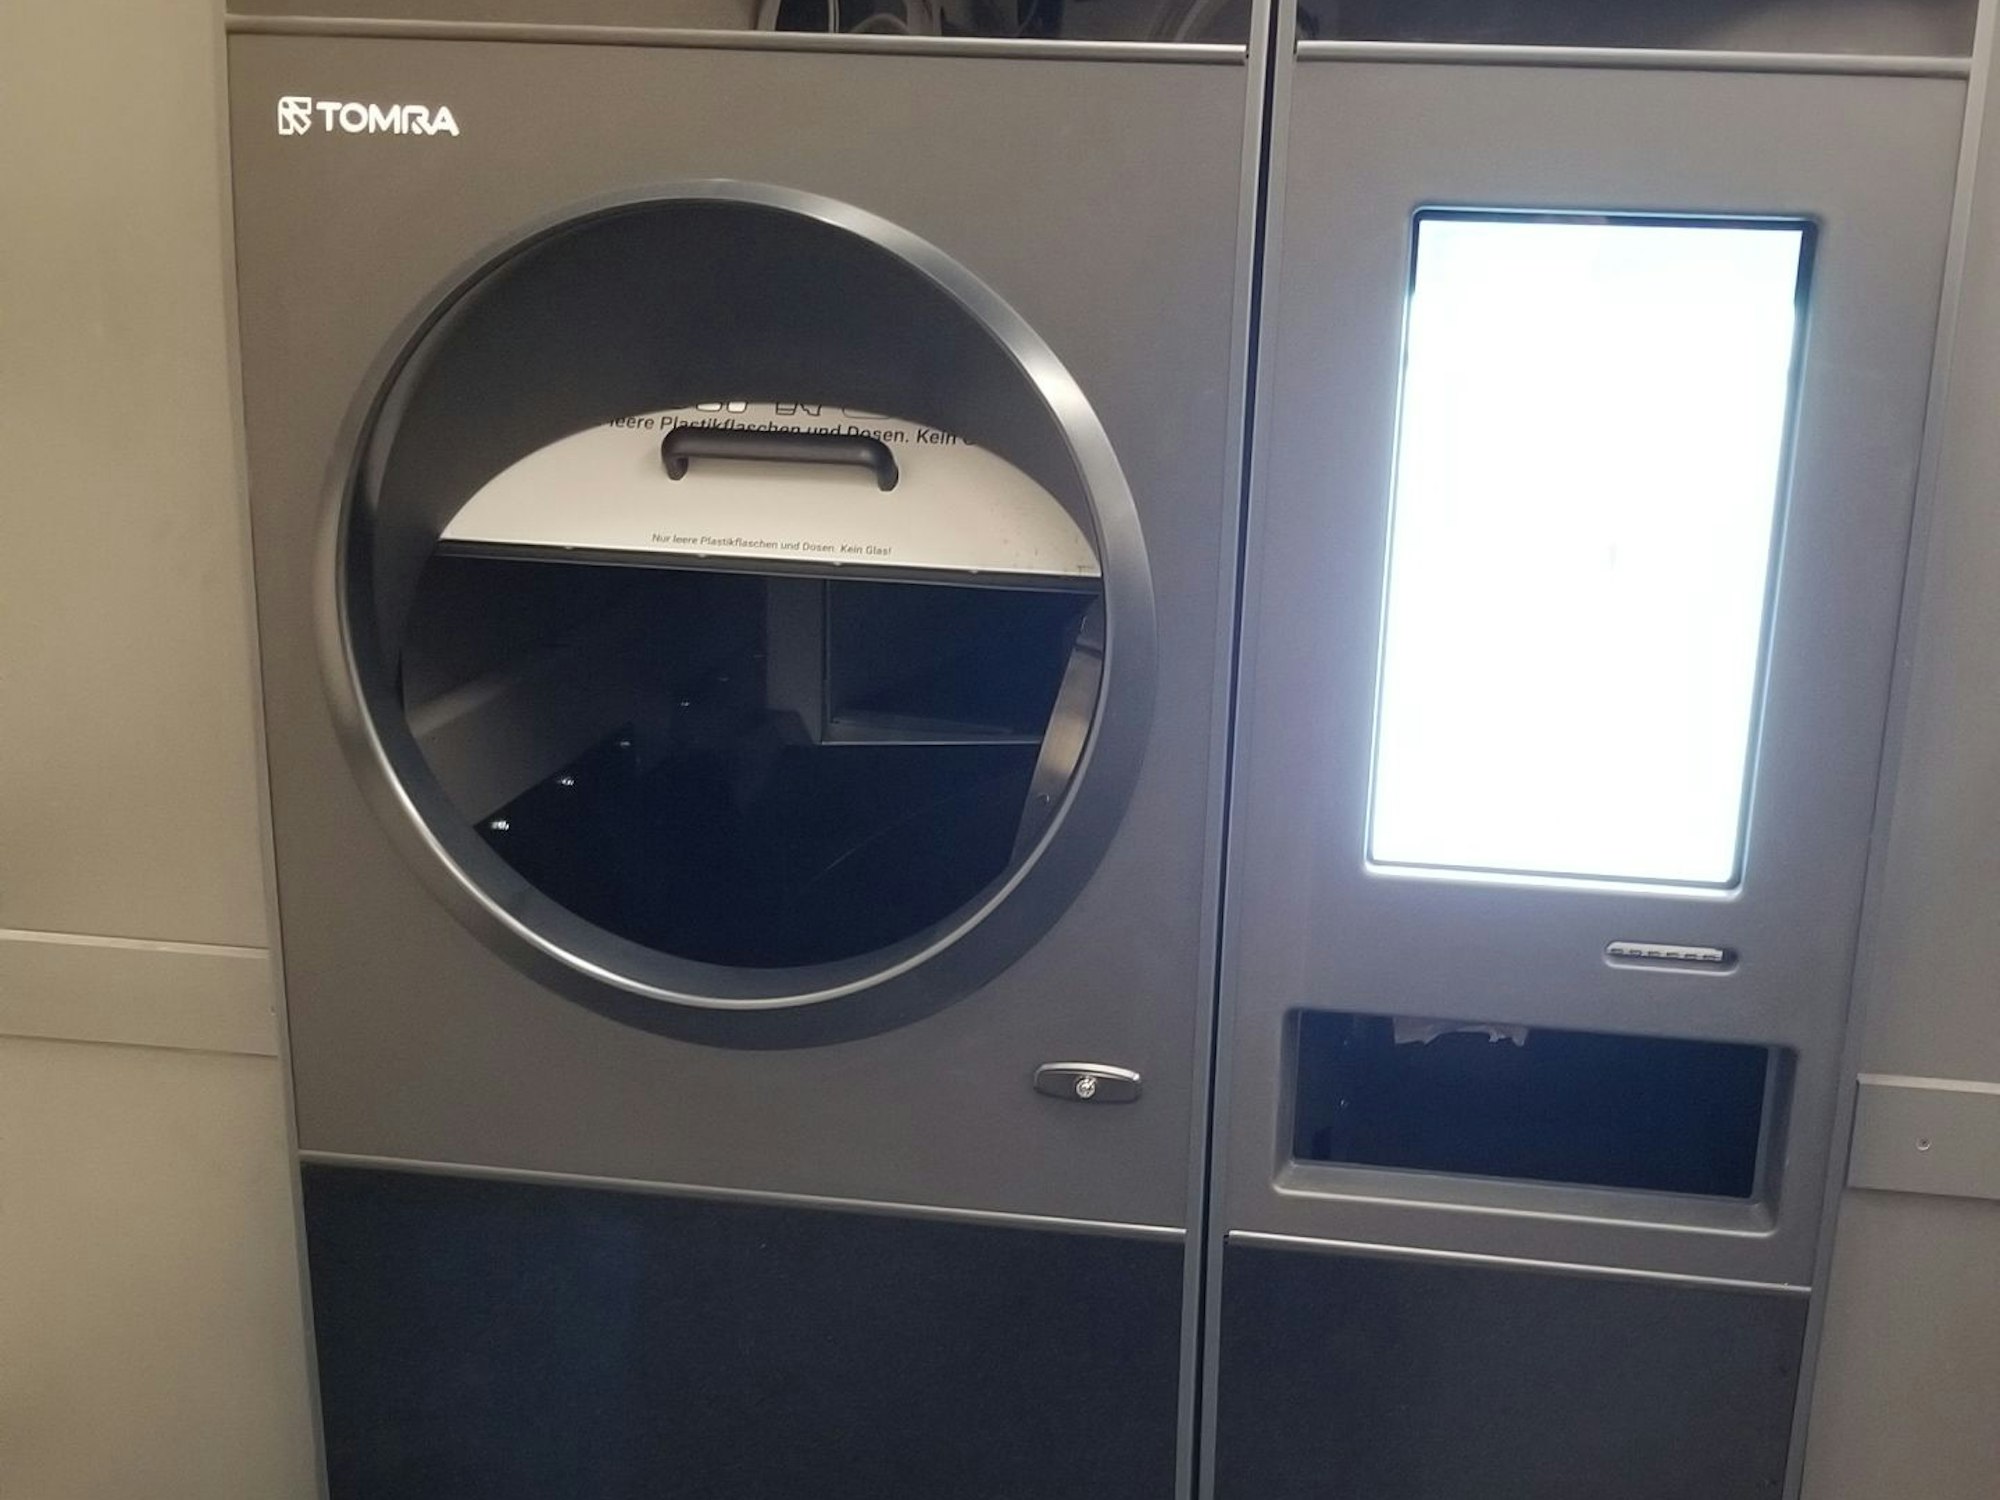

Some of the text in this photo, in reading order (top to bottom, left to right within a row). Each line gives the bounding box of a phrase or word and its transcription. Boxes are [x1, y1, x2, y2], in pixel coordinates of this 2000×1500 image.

[316, 101, 460, 136] TOMRA
[652, 533, 671, 543] Nur
[673, 534, 698, 545] leere
[700, 536, 778, 549] Plastikflaschen
[780, 541, 800, 550] und
[840, 544, 863, 555] Kein
[865, 545, 892, 556] Glas!
